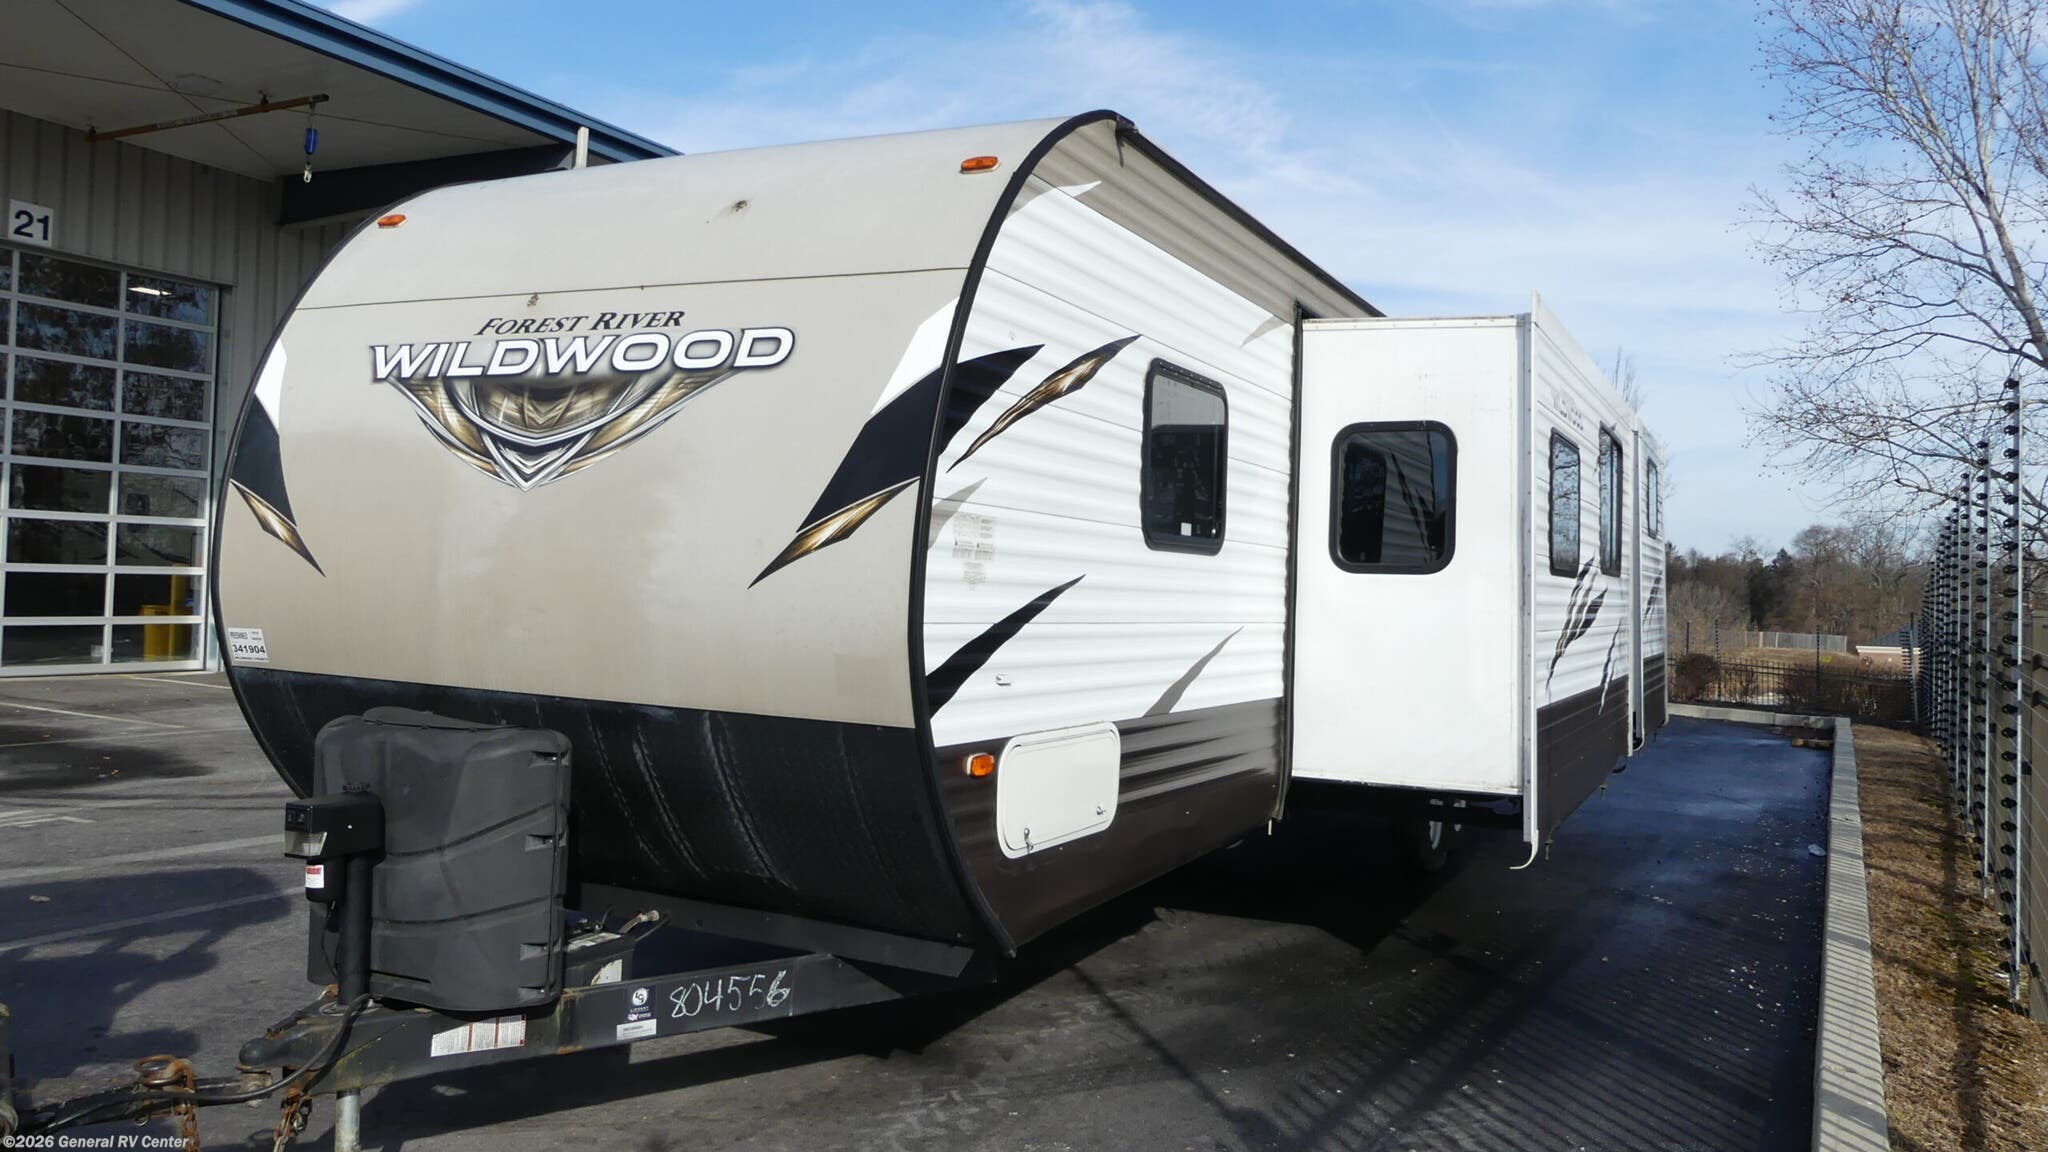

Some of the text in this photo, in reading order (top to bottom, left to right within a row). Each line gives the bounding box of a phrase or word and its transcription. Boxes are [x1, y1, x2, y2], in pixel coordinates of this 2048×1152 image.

[14, 209, 49, 241] 21
[474, 310, 686, 336] FOREST RIVER
[370, 326, 796, 383] WILDWOOD
[231, 643, 266, 654] 341904
[669, 969, 792, 1018] 804556
